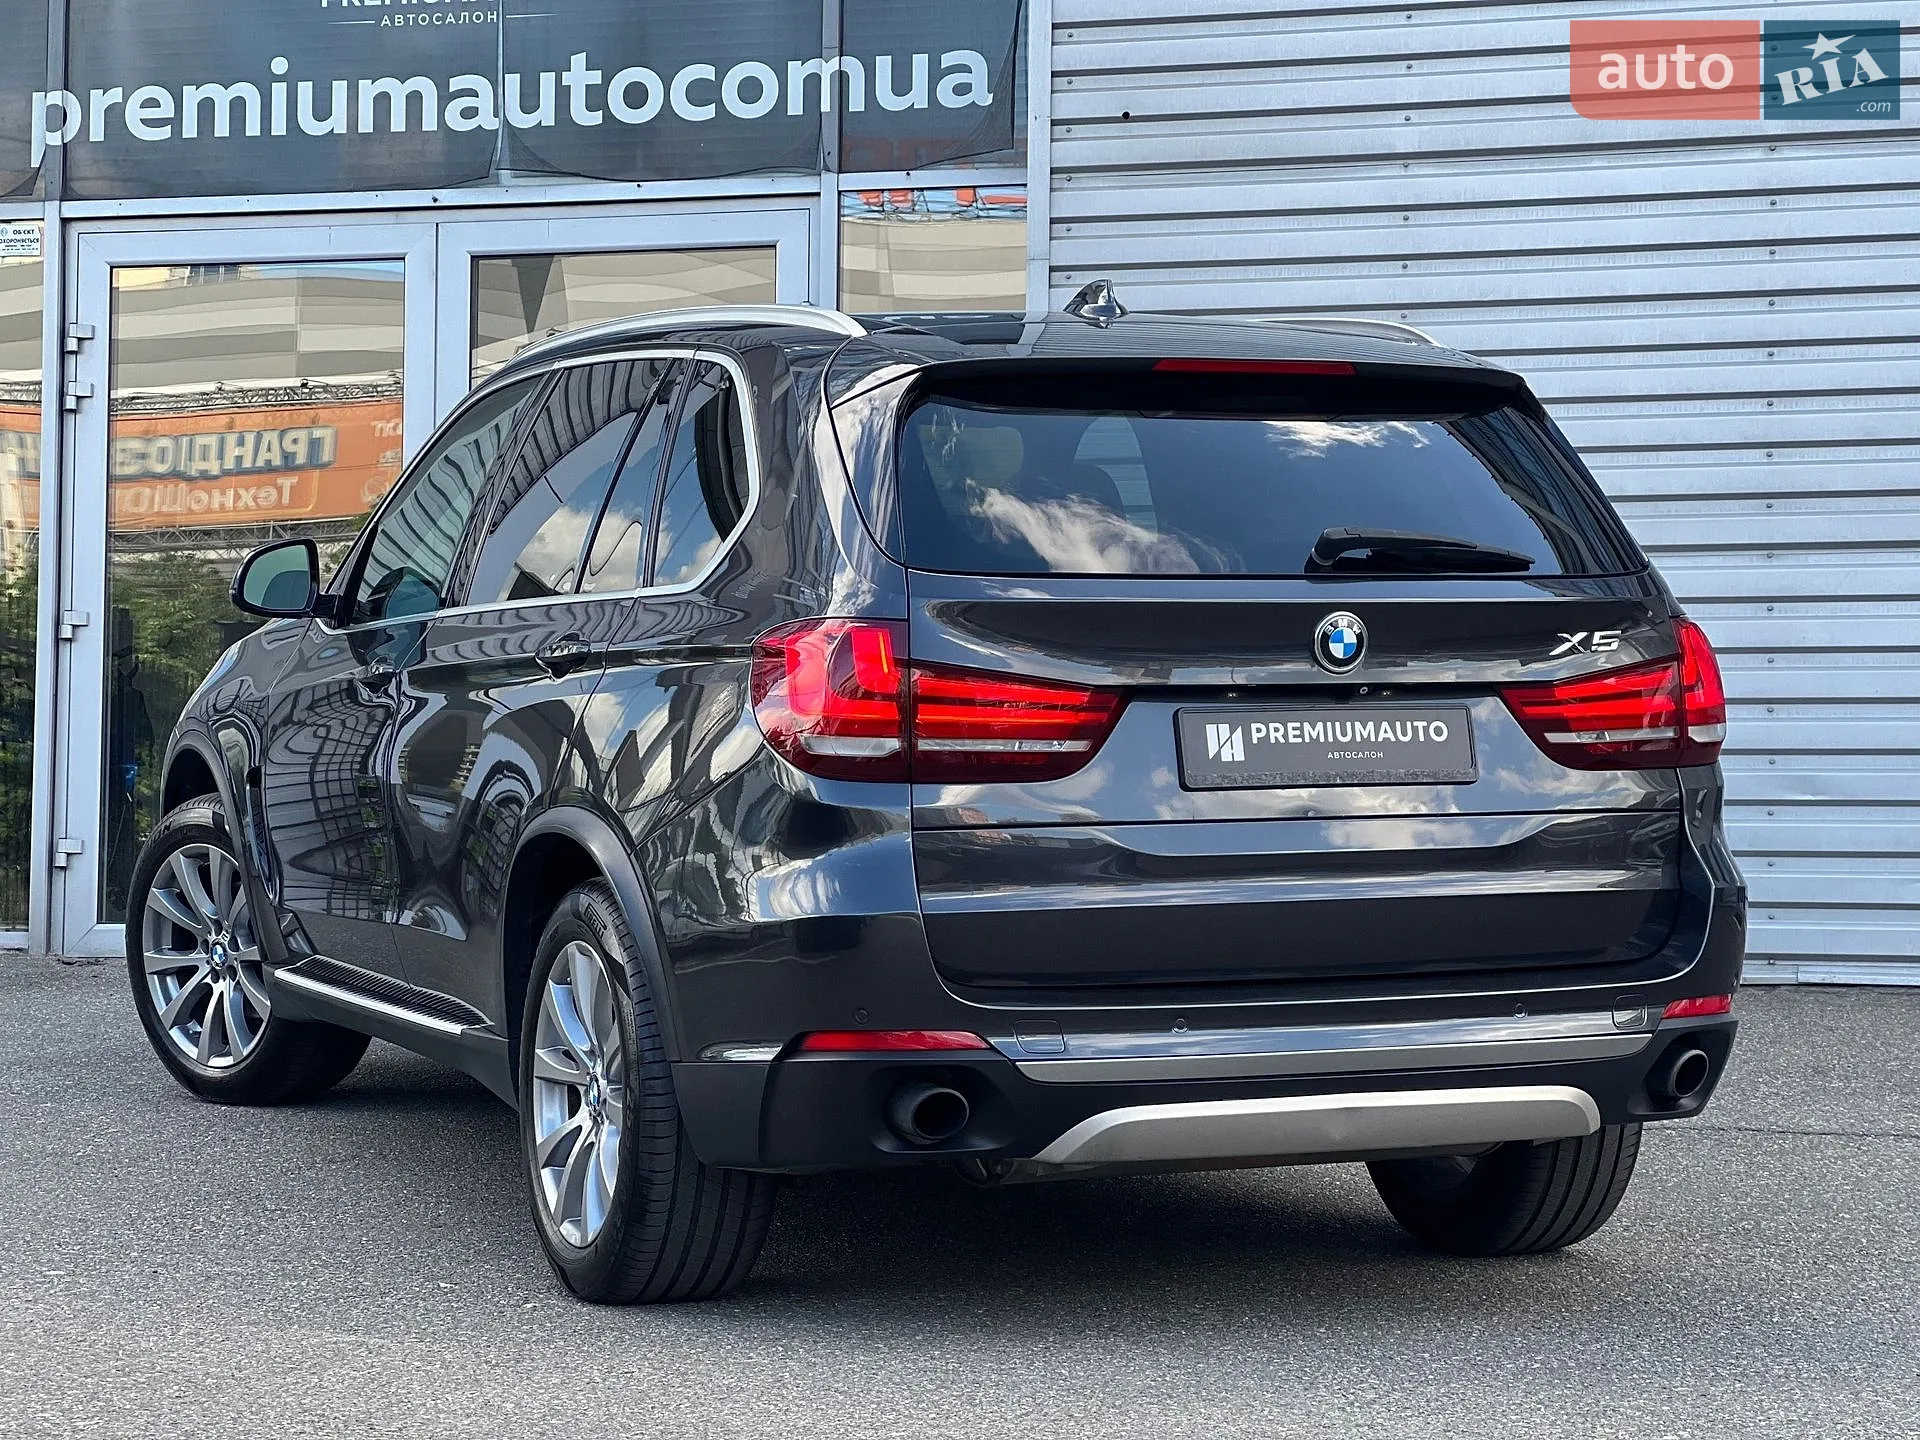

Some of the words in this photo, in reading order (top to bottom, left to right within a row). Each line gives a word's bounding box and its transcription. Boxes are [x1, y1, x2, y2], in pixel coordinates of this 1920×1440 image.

[380, 11, 497, 27] АВТОСАЛОН
[30, 49, 994, 168] premiumautocomua
[1323, 617, 1362, 636] BMW
[1548, 630, 1622, 656] X5
[1250, 720, 1449, 744] PREMIUMAUTO
[1327, 751, 1384, 759] АВТОСАЛОН
